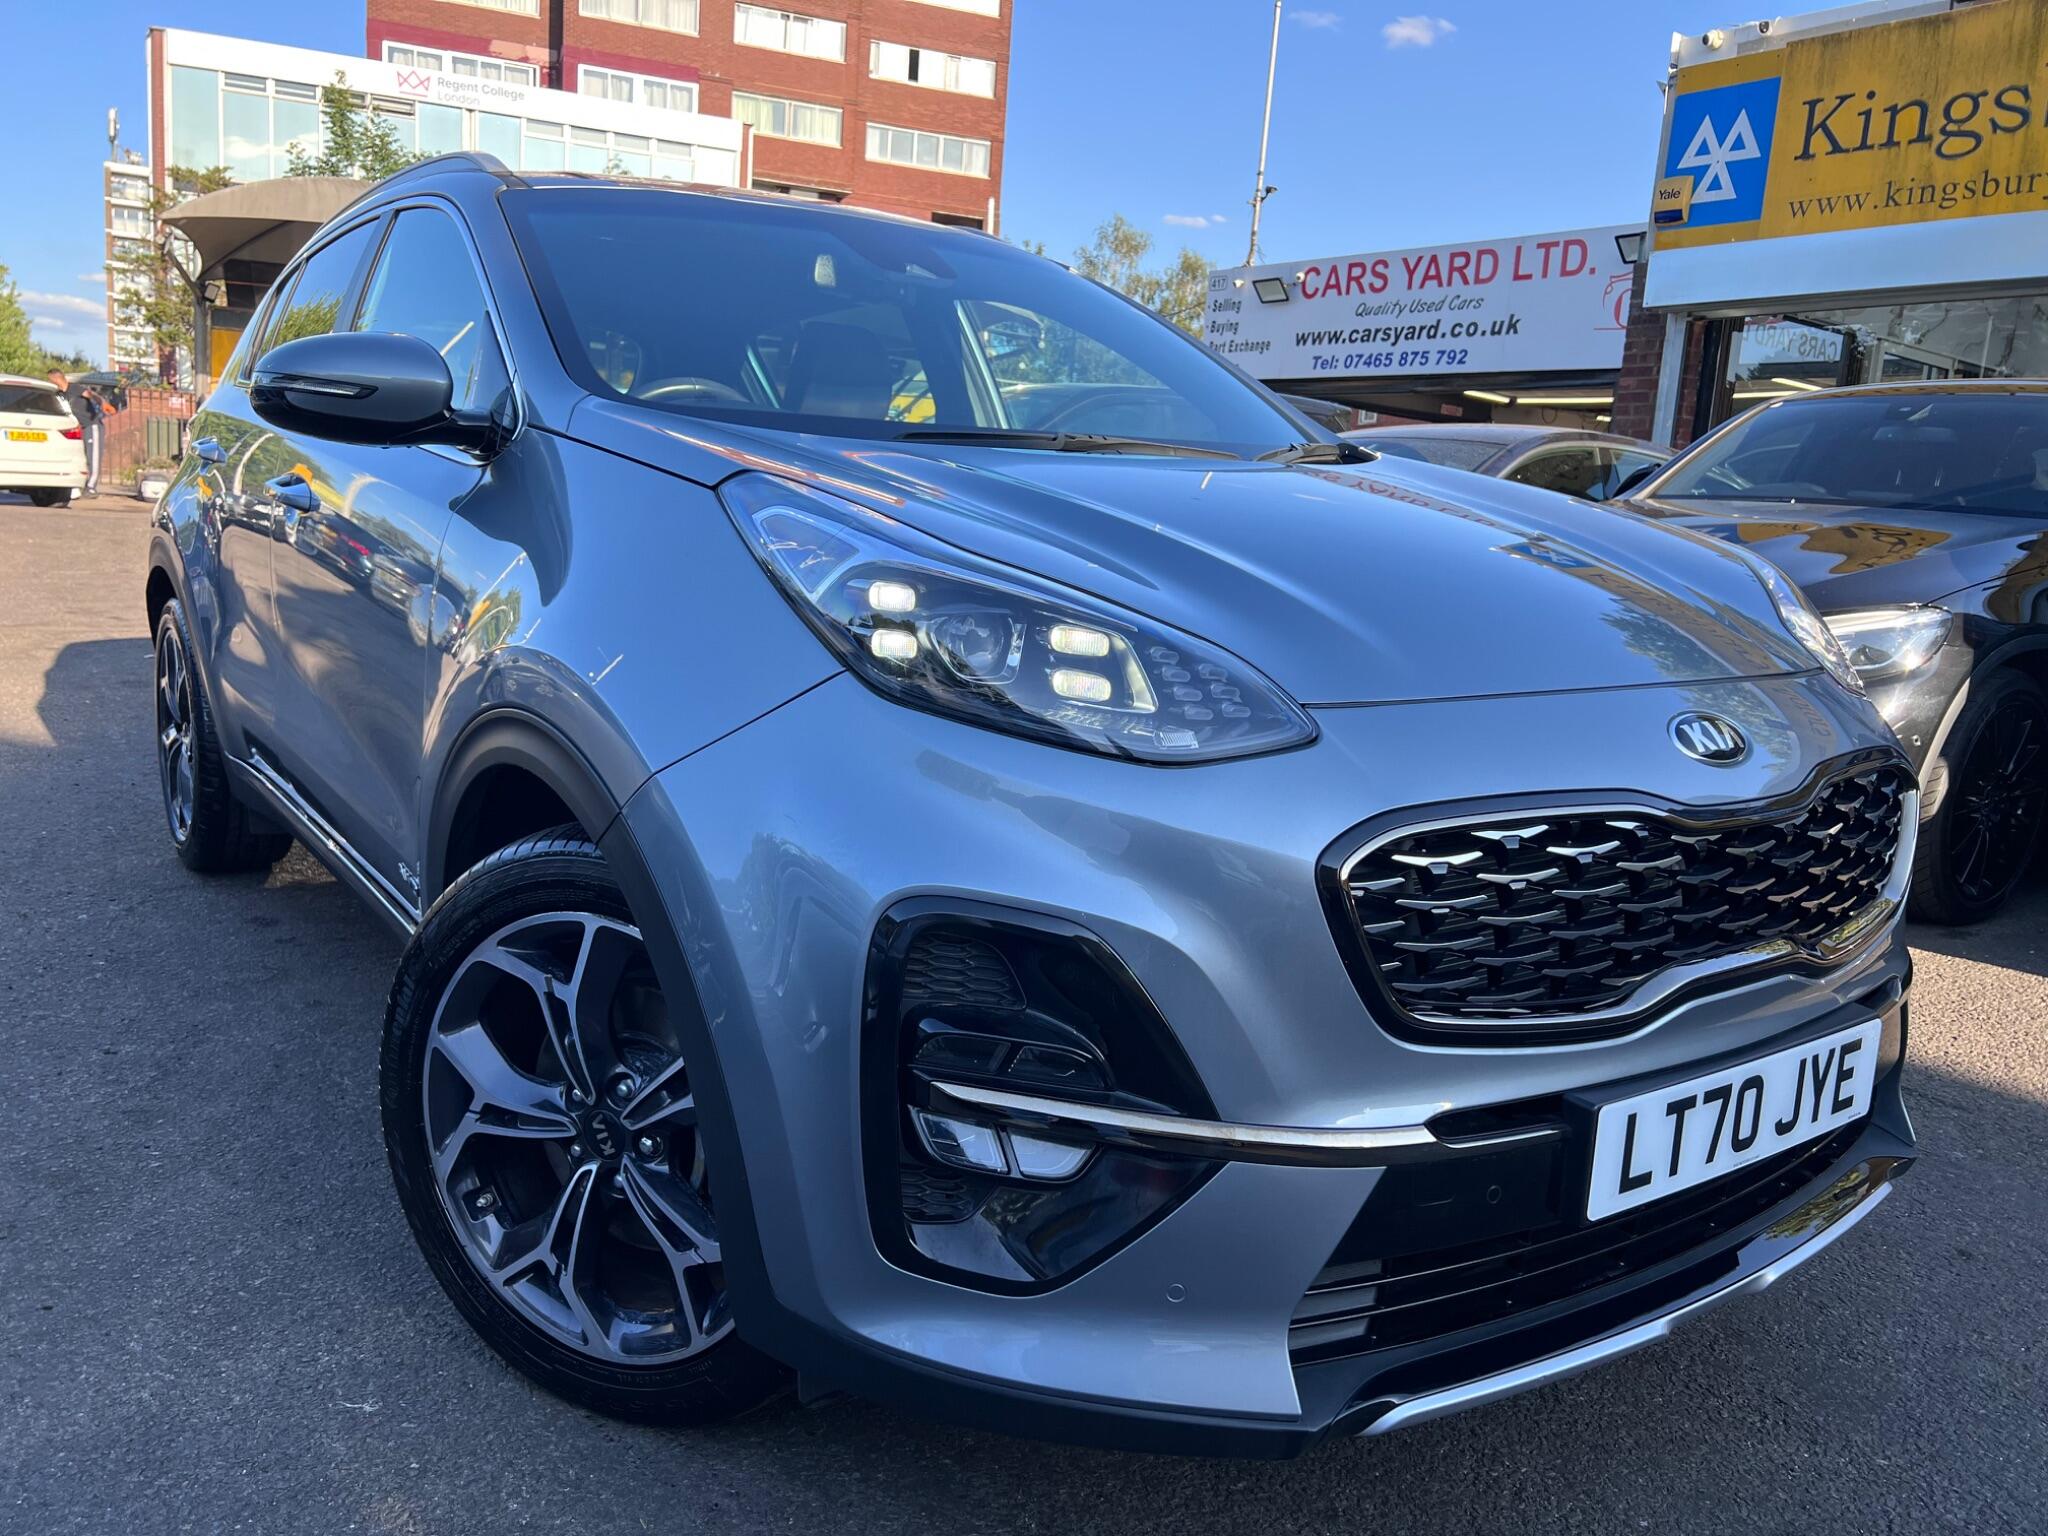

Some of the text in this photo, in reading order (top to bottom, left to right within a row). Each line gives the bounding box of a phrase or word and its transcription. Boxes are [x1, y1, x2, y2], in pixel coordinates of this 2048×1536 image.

[437, 77, 525, 101] Regent College
[437, 91, 480, 106] London
[1794, 64, 2048, 160] Kings
[1659, 188, 1681, 200] Yale
[1301, 239, 1597, 300] CARS YARD LTD.
[1211, 278, 1227, 289] 417
[1212, 298, 1242, 314] Selling
[1355, 294, 1484, 319] Quality Used Cars
[1210, 320, 1239, 336] Buying
[1295, 313, 1522, 347] www.carsyard.co.uk
[1228, 339, 1271, 355] Exchange
[1312, 348, 1468, 370] Tel: 07465 875 792
[1680, 720, 1745, 753] KIA
[1619, 1037, 1863, 1195] LT70 JYE
[592, 1114, 616, 1156] KIA
